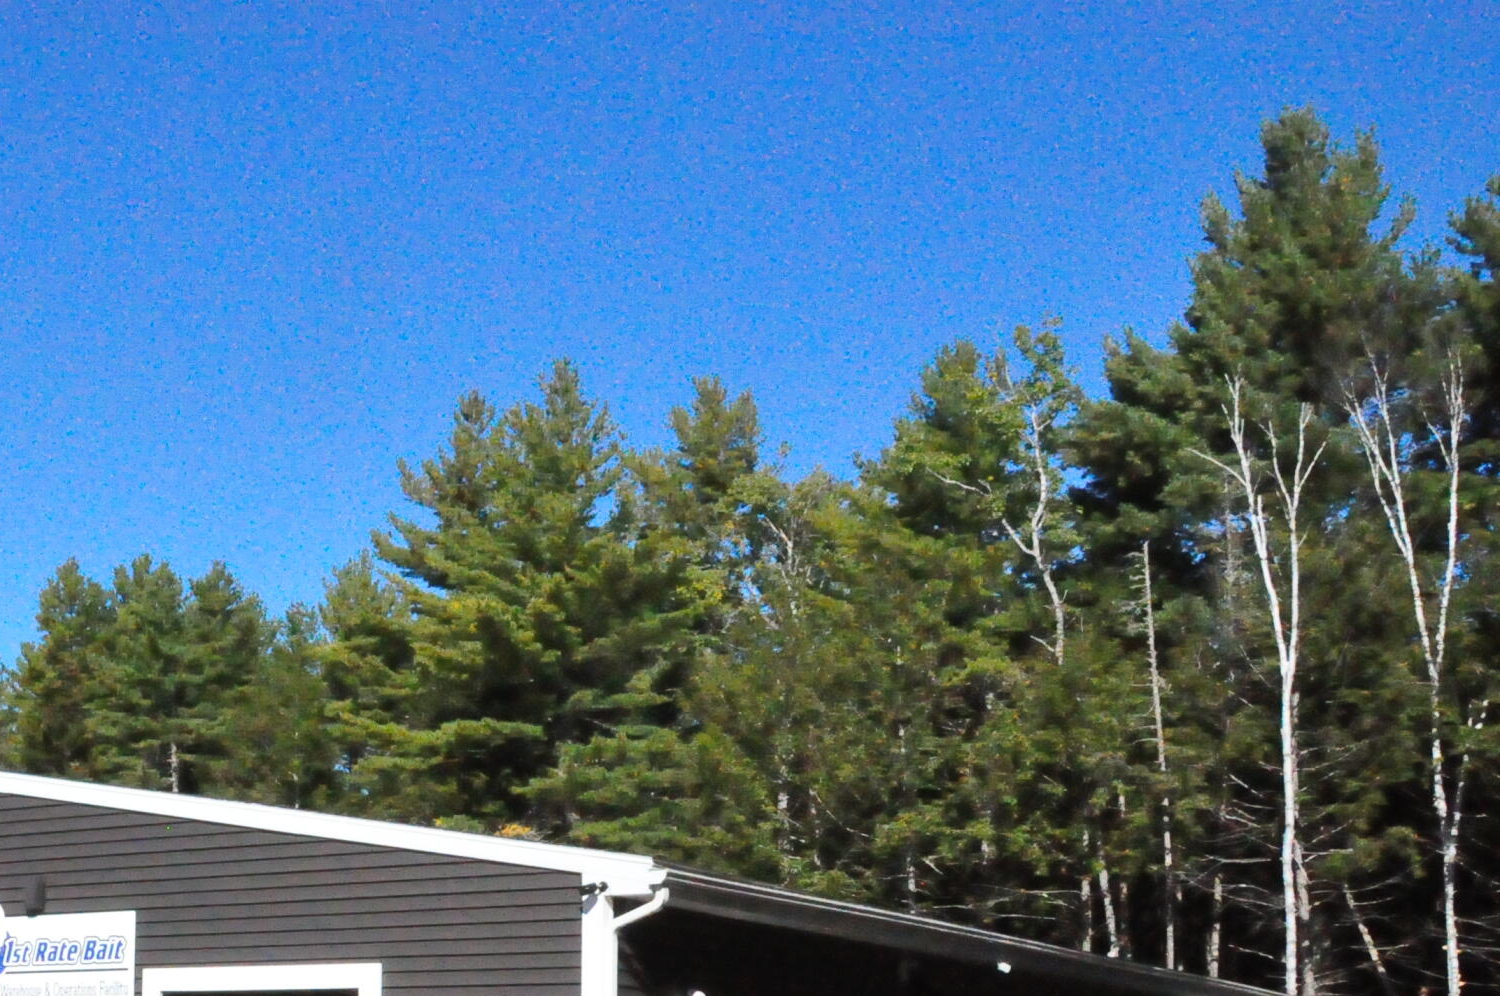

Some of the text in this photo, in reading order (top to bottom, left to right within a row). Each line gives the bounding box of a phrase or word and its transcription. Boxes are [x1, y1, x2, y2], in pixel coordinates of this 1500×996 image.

[5, 938, 124, 963] 1st Rate Bait
[45, 981, 51, 996] &
